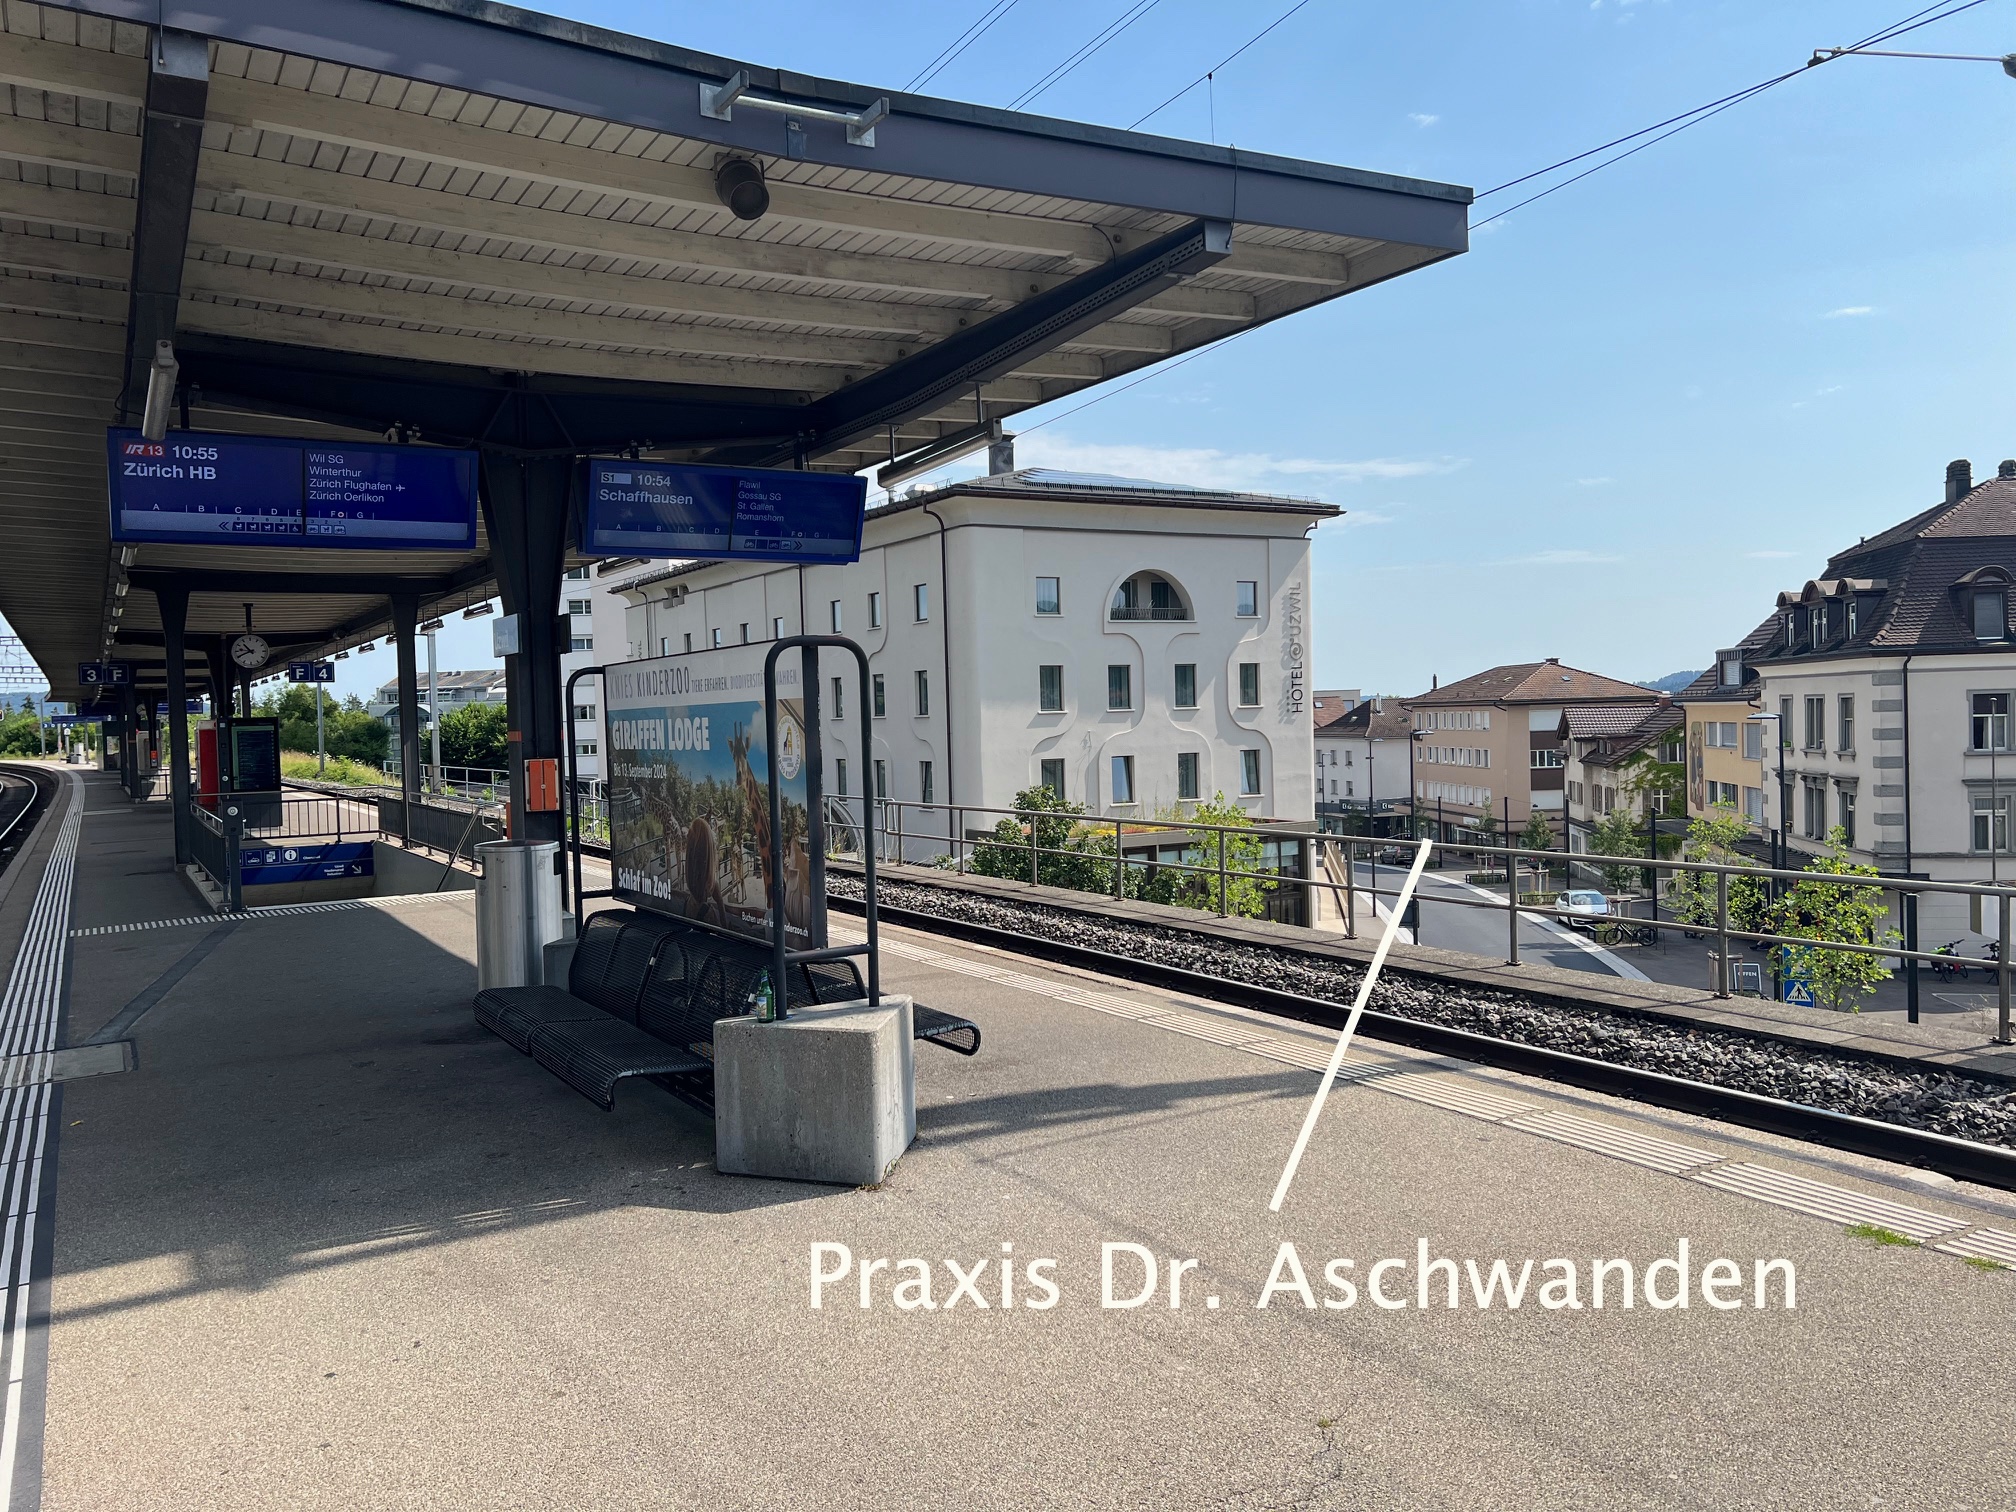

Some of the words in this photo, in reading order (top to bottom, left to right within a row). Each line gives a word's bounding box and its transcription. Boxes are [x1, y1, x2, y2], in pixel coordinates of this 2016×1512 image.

[147, 445, 163, 456] 13
[172, 445, 218, 460] 10:55
[309, 453, 325, 463] Wil
[327, 454, 344, 464] SG
[123, 462, 184, 478] Zürich
[189, 465, 217, 480] HB
[309, 466, 362, 477] Winterthur
[309, 478, 341, 488] Zürich
[344, 480, 392, 492] Flughafen
[602, 473, 615, 483] S1
[637, 474, 672, 487] 10:54
[739, 480, 761, 489] Flawil
[309, 490, 341, 500] Zürich
[343, 492, 385, 503] Oerlikon
[599, 488, 693, 505] Schaffhausen
[737, 491, 768, 500] Gossau
[769, 492, 782, 501] SG
[152, 503, 160, 511] A
[234, 506, 242, 514] C
[737, 502, 748, 510] St.
[750, 502, 774, 511] Gallen
[736, 512, 785, 522] Romanshorn
[1289, 582, 1302, 638] UZWIL
[87, 669, 97, 681] 3
[113, 669, 122, 681] F
[296, 668, 305, 679] F
[318, 668, 328, 679] 4
[609, 673, 633, 700] KNIES
[636, 666, 690, 698] KINDERZOO
[704, 676, 729, 692] ERFAHREN.
[730, 669, 765, 690] BIODIVERSITÄ
[1291, 661, 1304, 713] HOTEL
[612, 718, 665, 751] GIRAFFEN
[667, 716, 710, 751] LODGE
[613, 762, 621, 776] Bis
[628, 763, 653, 781] September
[652, 764, 667, 779] 2024
[618, 866, 641, 892] Schlaf
[641, 874, 652, 895] im
[653, 874, 672, 900] Zoo!
[741, 911, 756, 923] Buchen
[769, 917, 809, 937] knnderzoo.ch
